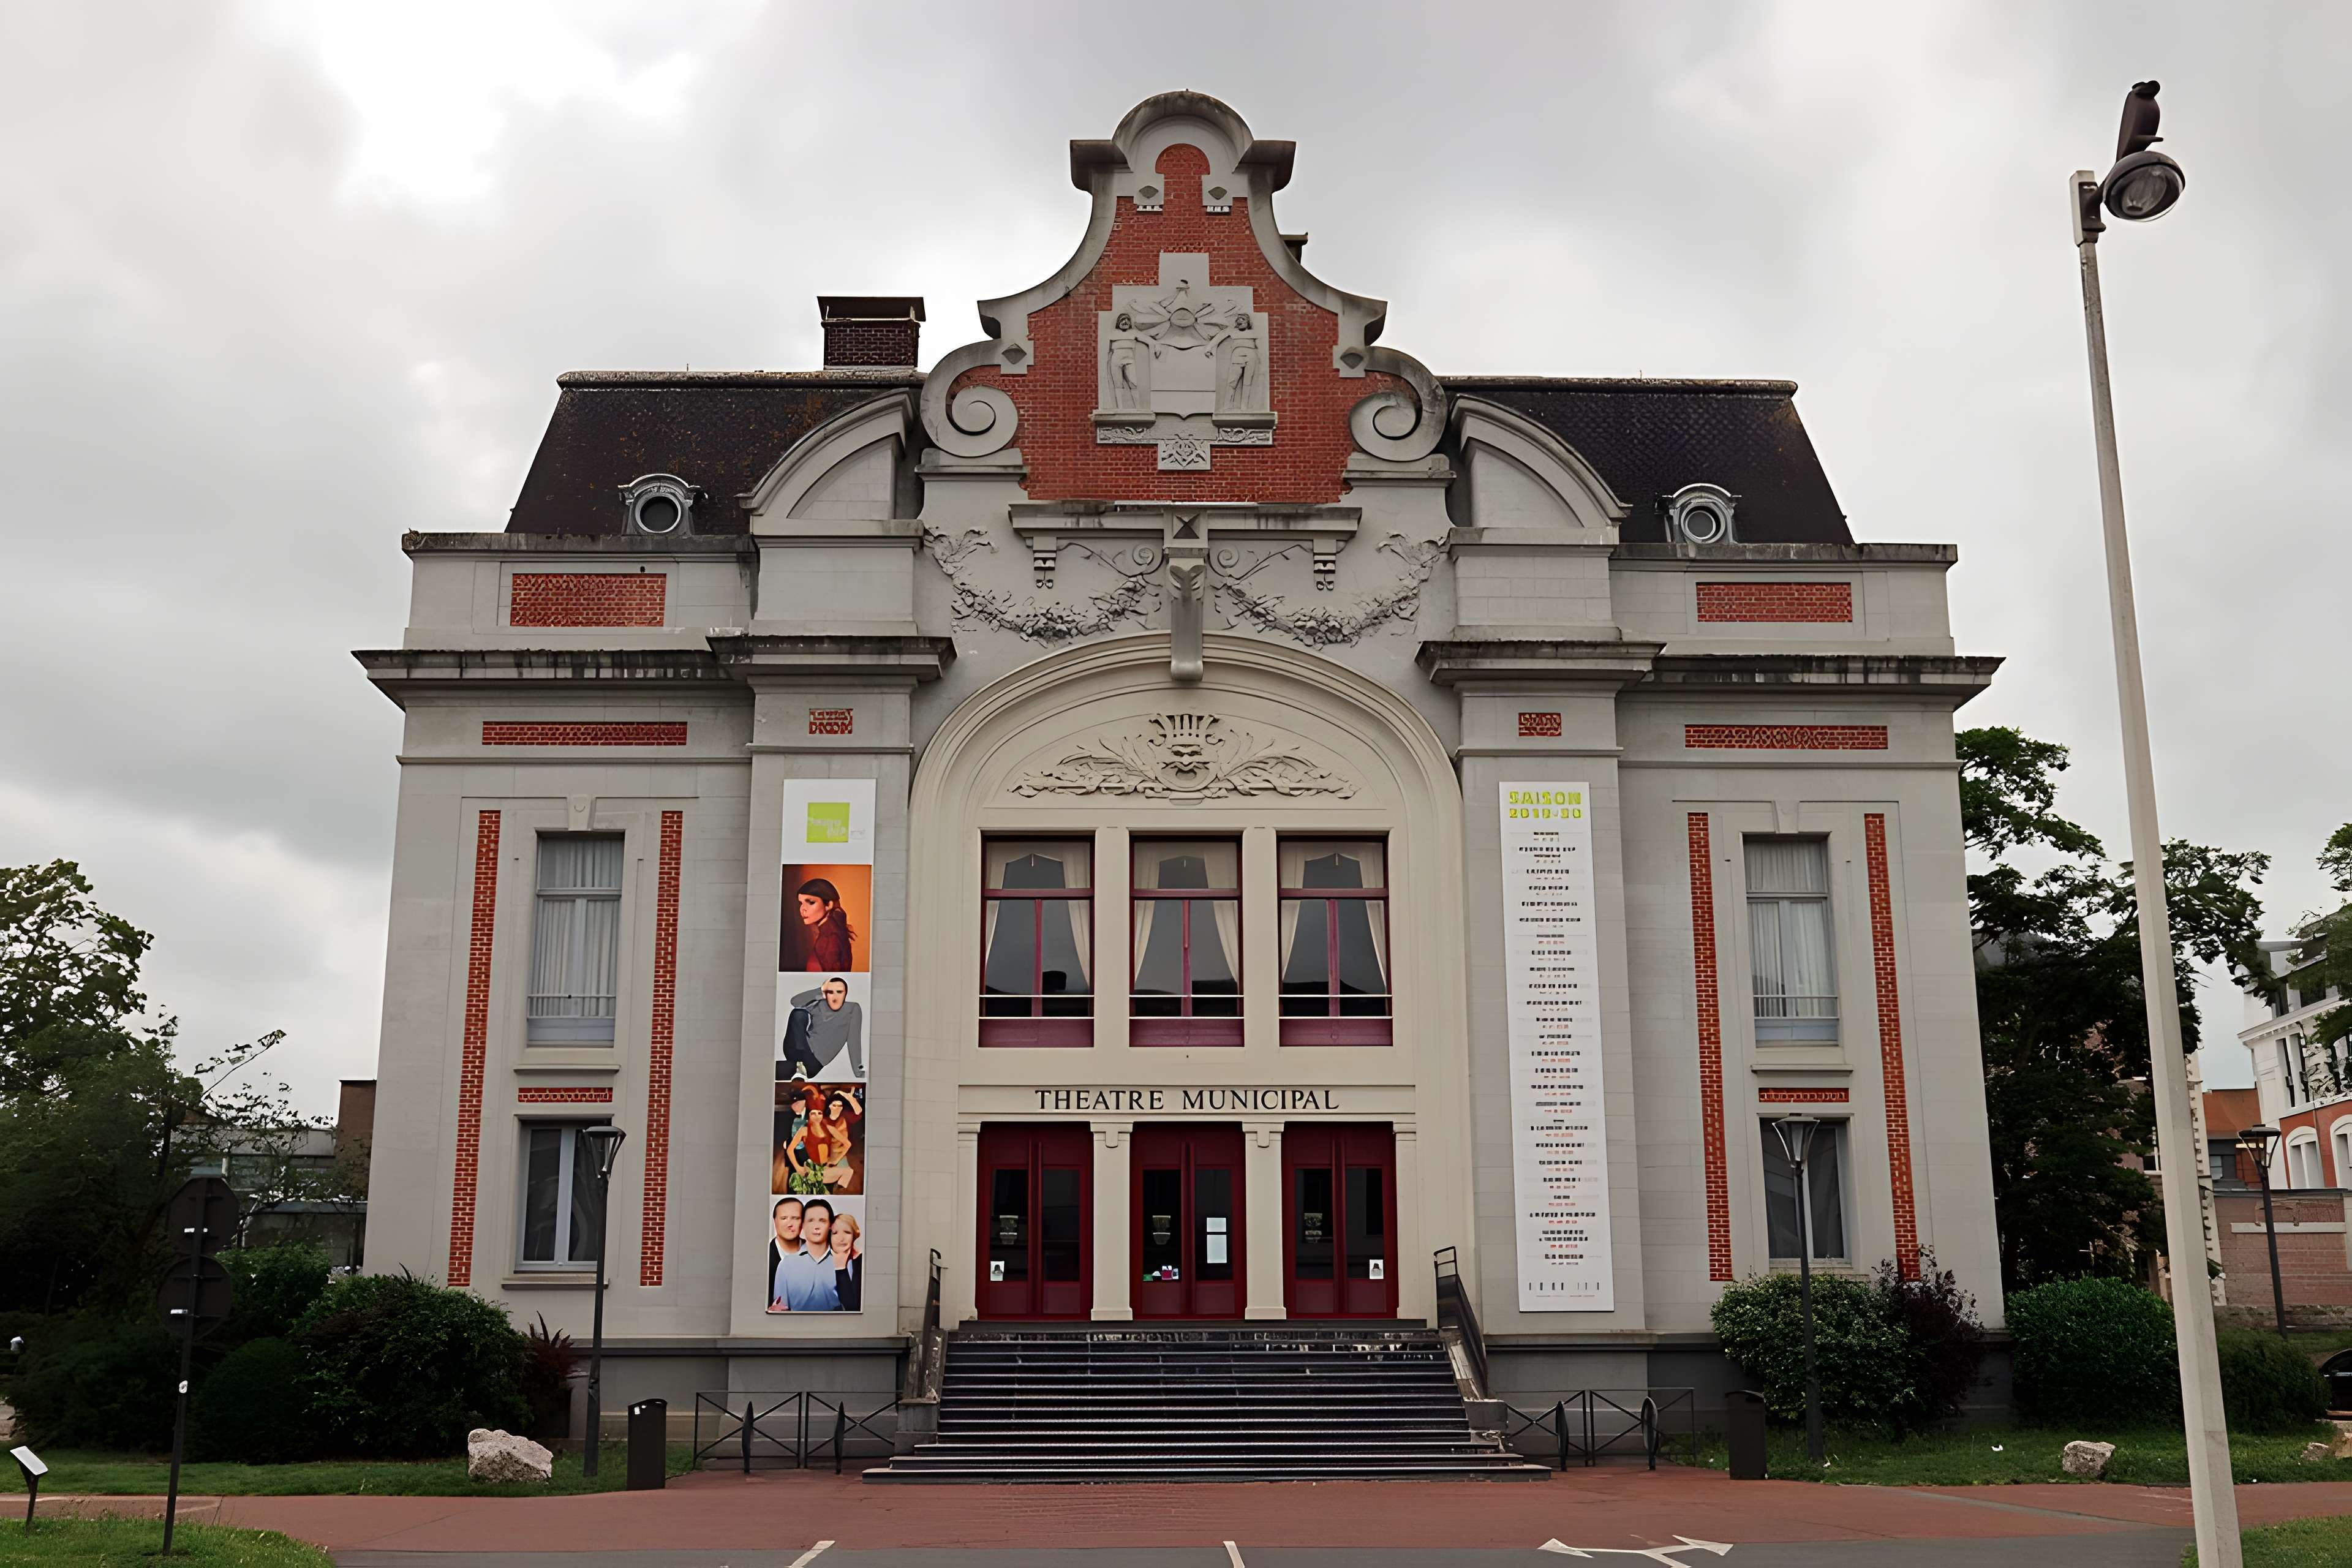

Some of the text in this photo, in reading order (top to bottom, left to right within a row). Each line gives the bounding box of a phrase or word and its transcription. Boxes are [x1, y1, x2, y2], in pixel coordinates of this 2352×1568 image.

[1509, 791, 1581, 805] SAISON
[1035, 1090, 1340, 1110] THEATRE MUNICIPAL
